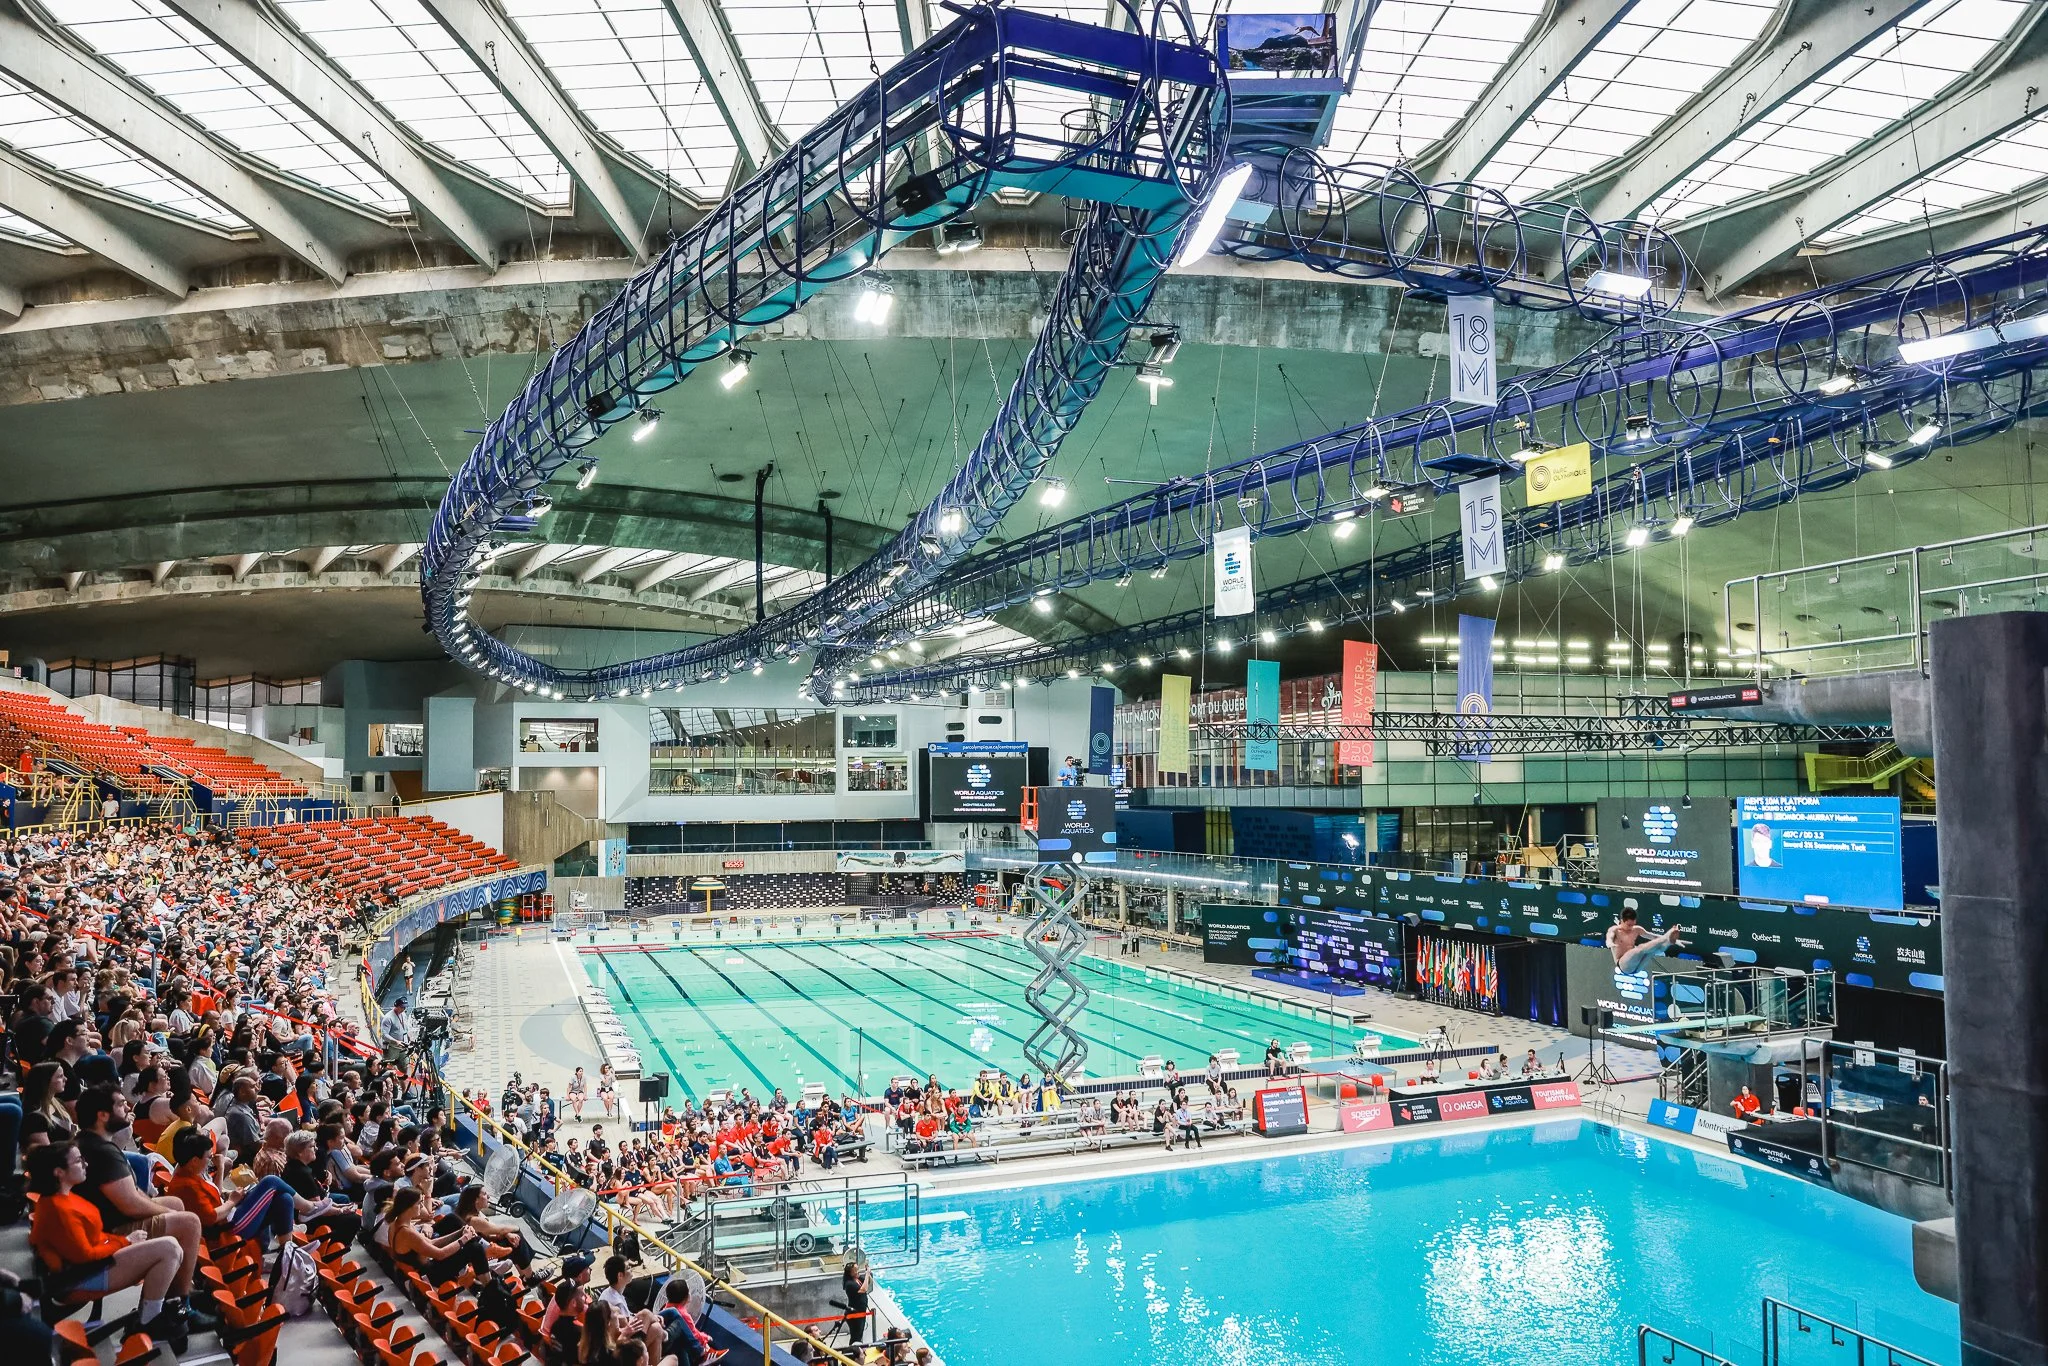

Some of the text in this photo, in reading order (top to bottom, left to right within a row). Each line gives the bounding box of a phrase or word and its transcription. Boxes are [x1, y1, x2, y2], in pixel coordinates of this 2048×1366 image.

[1453, 313, 1490, 355] 18
[1458, 353, 1489, 396] M
[1553, 469, 1587, 481] OLYMPIQUE
[1465, 495, 1498, 534] 15
[1470, 530, 1498, 570] M
[1222, 577, 1244, 586] WORLD
[1220, 583, 1247, 593] AQUATICS
[1353, 660, 1365, 708] WATER-
[1113, 695, 1247, 725] STITUT NATION ORT DU QUÉB
[1780, 797, 1820, 806] PLATFORM
[1060, 827, 1094, 835] AQUATICS
[1626, 847, 1698, 859] WORLD AQUATICS
[1676, 924, 1698, 934] Canada
[1709, 928, 1731, 937] Montréal
[1751, 932, 1773, 942] Québec
[1852, 956, 1876, 964] AQUATICS
[1597, 999, 1654, 1016] WORLD AQUA
[1454, 1100, 1484, 1111] OMEGA
[1350, 1106, 1381, 1121] speedo
[1413, 1108, 1433, 1116] PLONGEON
[1758, 1146, 1792, 1161] MONTRÉAL
[1767, 1155, 1784, 1165] 2023
